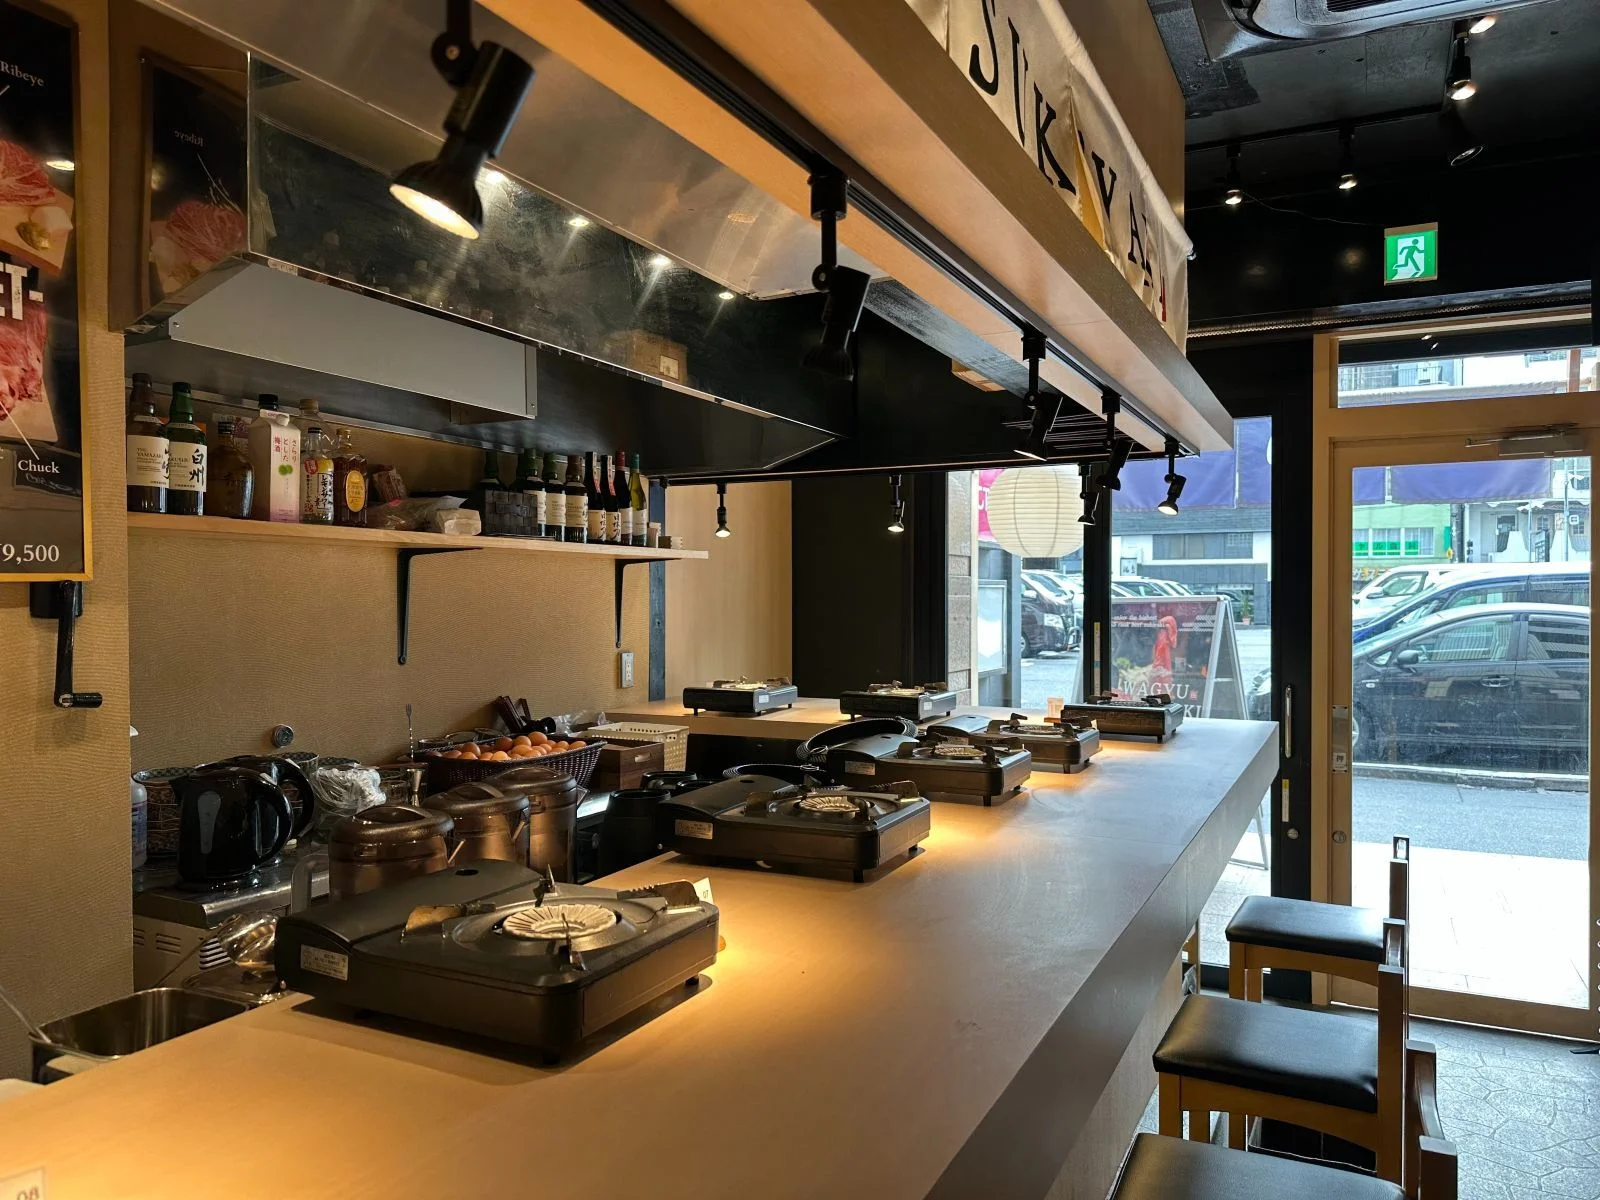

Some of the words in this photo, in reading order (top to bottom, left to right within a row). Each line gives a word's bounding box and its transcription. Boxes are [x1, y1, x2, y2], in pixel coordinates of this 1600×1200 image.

[0, 60, 44, 87] Ribeye
[0, 261, 43, 320] T-
[18, 459, 60, 474] Chuck
[189, 448, 205, 486] 白州
[0, 543, 60, 566] 9,500
[1123, 680, 1190, 699] WAGYU
